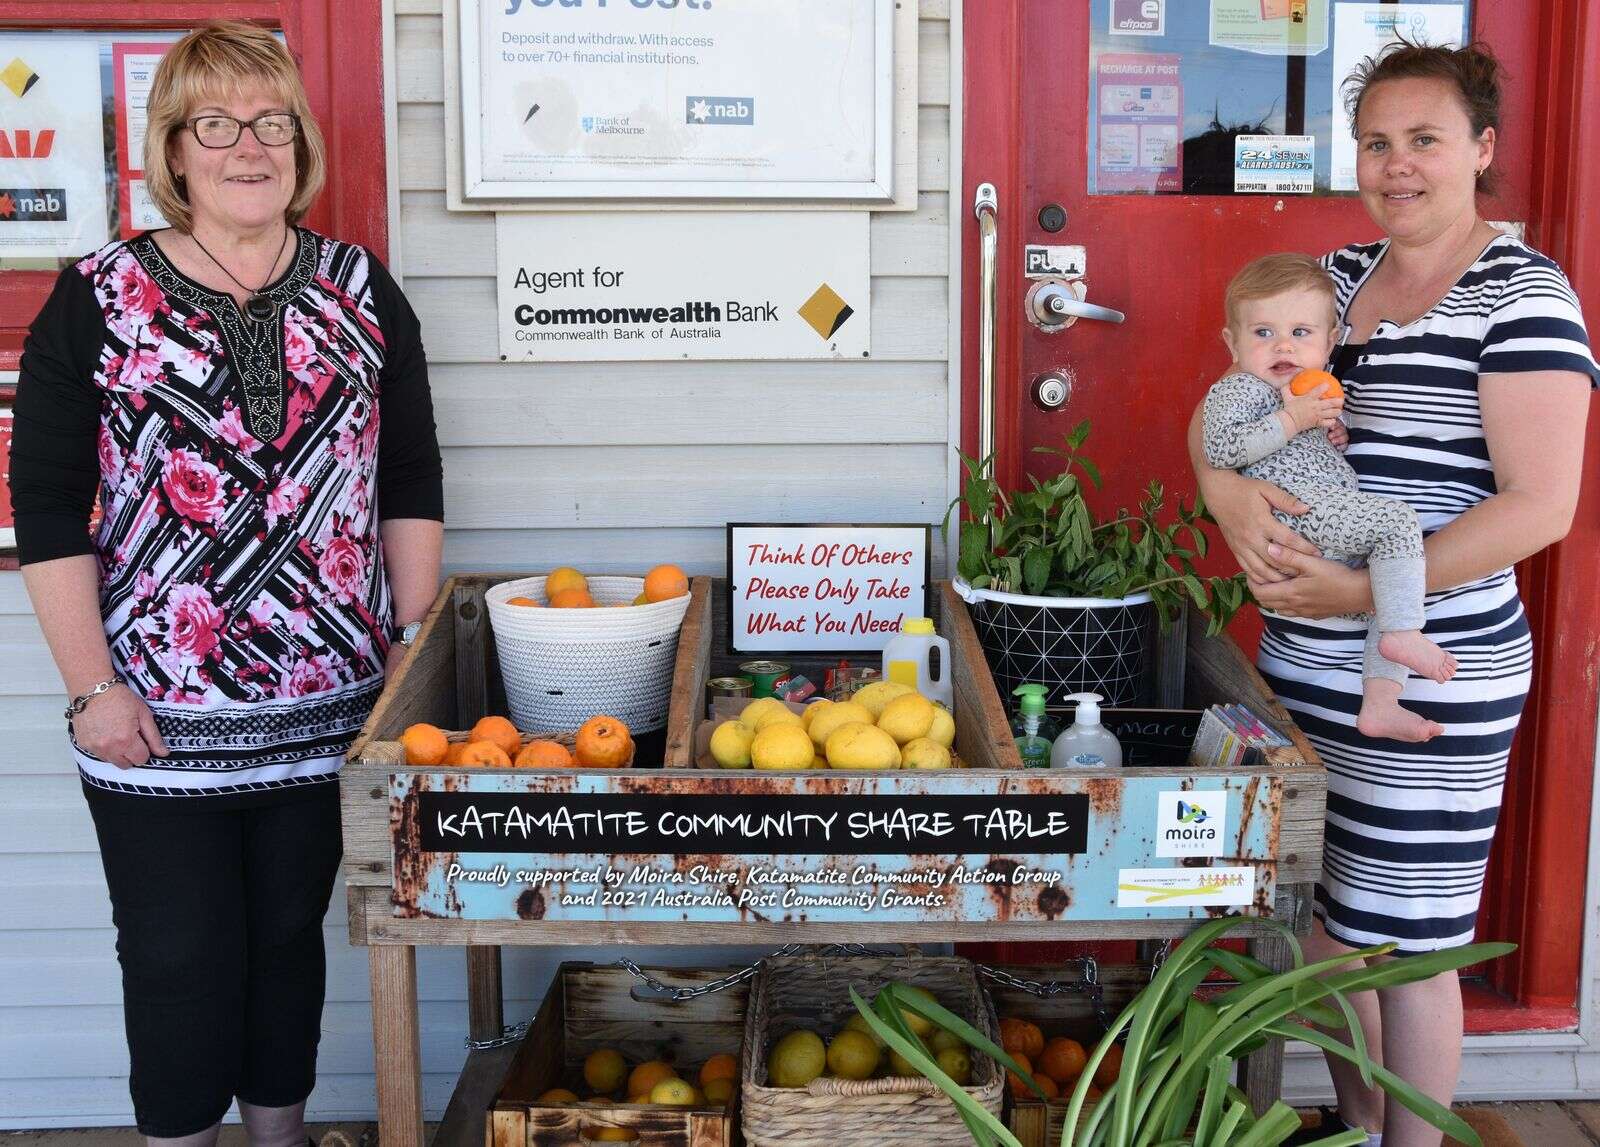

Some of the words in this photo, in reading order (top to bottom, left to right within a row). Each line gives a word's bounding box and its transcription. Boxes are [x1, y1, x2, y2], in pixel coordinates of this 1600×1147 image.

[1120, 18, 1153, 30] eftpos
[502, 32, 553, 45] Deposit
[553, 33, 575, 44] and
[578, 33, 636, 45] withdraw.
[639, 34, 668, 46] With
[670, 37, 714, 47] access
[502, 51, 515, 62] to
[517, 53, 545, 63] over
[548, 51, 570, 63] 70+
[573, 51, 624, 63] financial
[627, 52, 699, 65] institutions.
[1100, 64, 1144, 74] RECHARGE
[1144, 64, 1155, 74] AT
[1156, 64, 1179, 74] POST
[714, 102, 748, 118] nab
[595, 117, 619, 126] Bank
[620, 117, 630, 126] of
[595, 126, 645, 135] Melbourne
[1241, 150, 1273, 160] 24
[1275, 151, 1311, 160] SEVEN
[1240, 161, 1273, 169] ALARMS
[1275, 161, 1296, 169] AUST
[1236, 183, 1267, 191] SHEPPARTON
[1276, 183, 1291, 191] 1800
[1292, 183, 1303, 191] 247
[20, 194, 60, 213] nab
[514, 268, 584, 294] Agent
[593, 266, 624, 287] for
[514, 302, 721, 326] Commonwealth
[726, 301, 779, 322] Bank
[515, 329, 609, 342] Commonwealth
[614, 328, 645, 340] Bank
[651, 327, 664, 340] of
[670, 327, 721, 339] Australia
[748, 544, 805, 566] Think
[811, 543, 840, 568] Of
[841, 543, 913, 567] Others
[746, 578, 809, 600] Please
[815, 578, 859, 605] Only
[866, 578, 910, 600] Take
[747, 612, 806, 635] What
[815, 612, 846, 635] You
[437, 805, 649, 840] KATAMATITE
[658, 809, 838, 841] COMMUNITY
[848, 807, 955, 841] SHARE
[963, 807, 1070, 841] TABLE
[1165, 825, 1216, 840] moira
[446, 864, 510, 887] Proudly
[515, 865, 600, 887] supported
[604, 865, 624, 887] by
[628, 865, 684, 884] Moira
[689, 865, 740, 885] Shire,
[746, 865, 847, 885] Katamatite
[851, 865, 947, 888] Community
[949, 865, 1006, 885] Action
[1011, 864, 1062, 889] Group
[561, 888, 596, 907] and
[601, 888, 647, 907] 2021
[650, 888, 736, 907] Australia
[737, 888, 777, 908] Post
[781, 888, 878, 911] Community
[880, 888, 947, 908] Grants.
